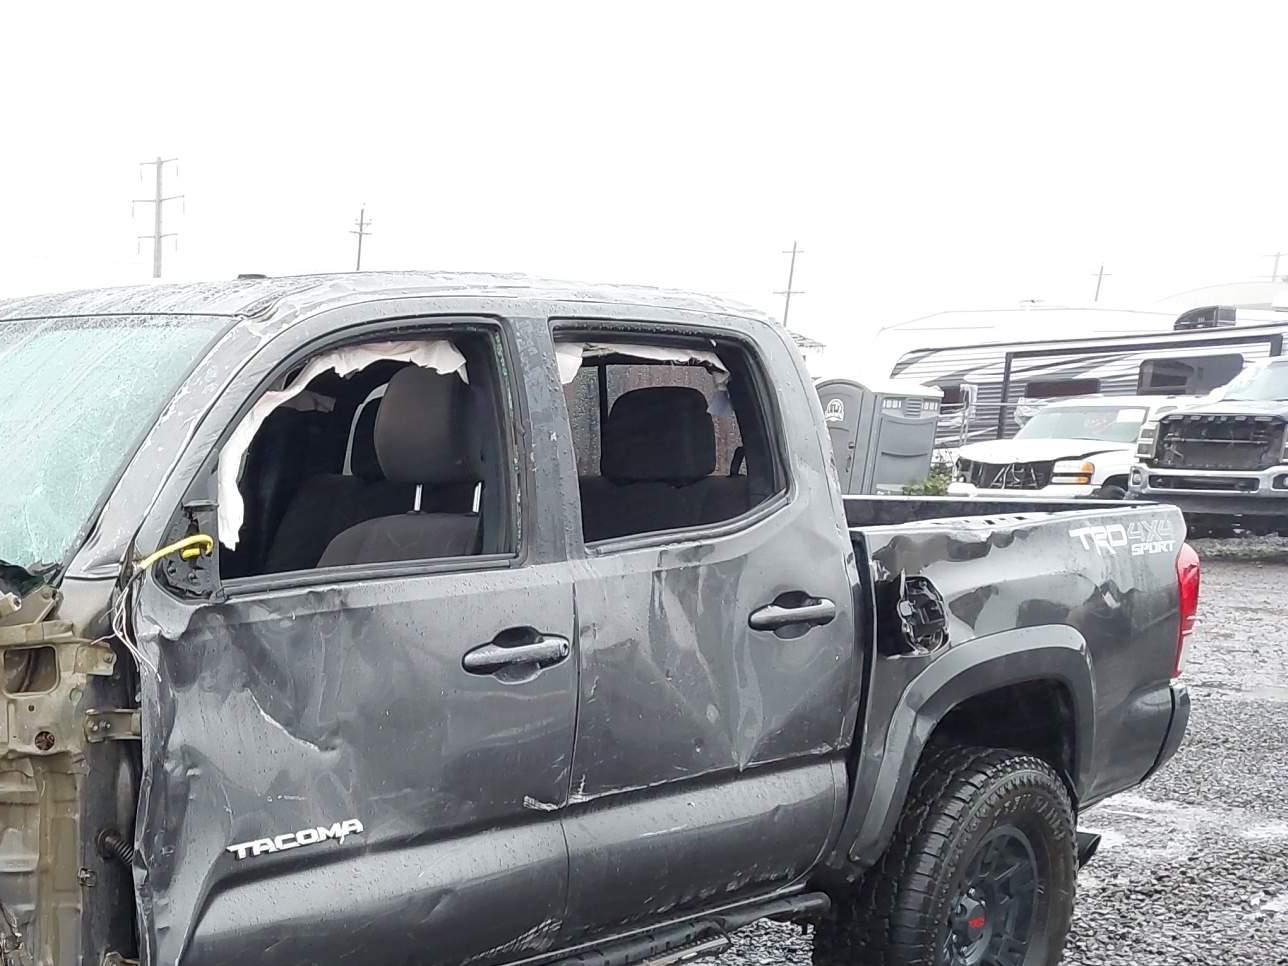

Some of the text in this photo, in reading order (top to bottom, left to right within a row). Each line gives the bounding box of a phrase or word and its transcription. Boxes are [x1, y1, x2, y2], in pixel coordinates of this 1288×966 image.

[1069, 524, 1127, 556] TRD
[1131, 540, 1176, 556] SPORT
[227, 818, 364, 860] TACOMA
